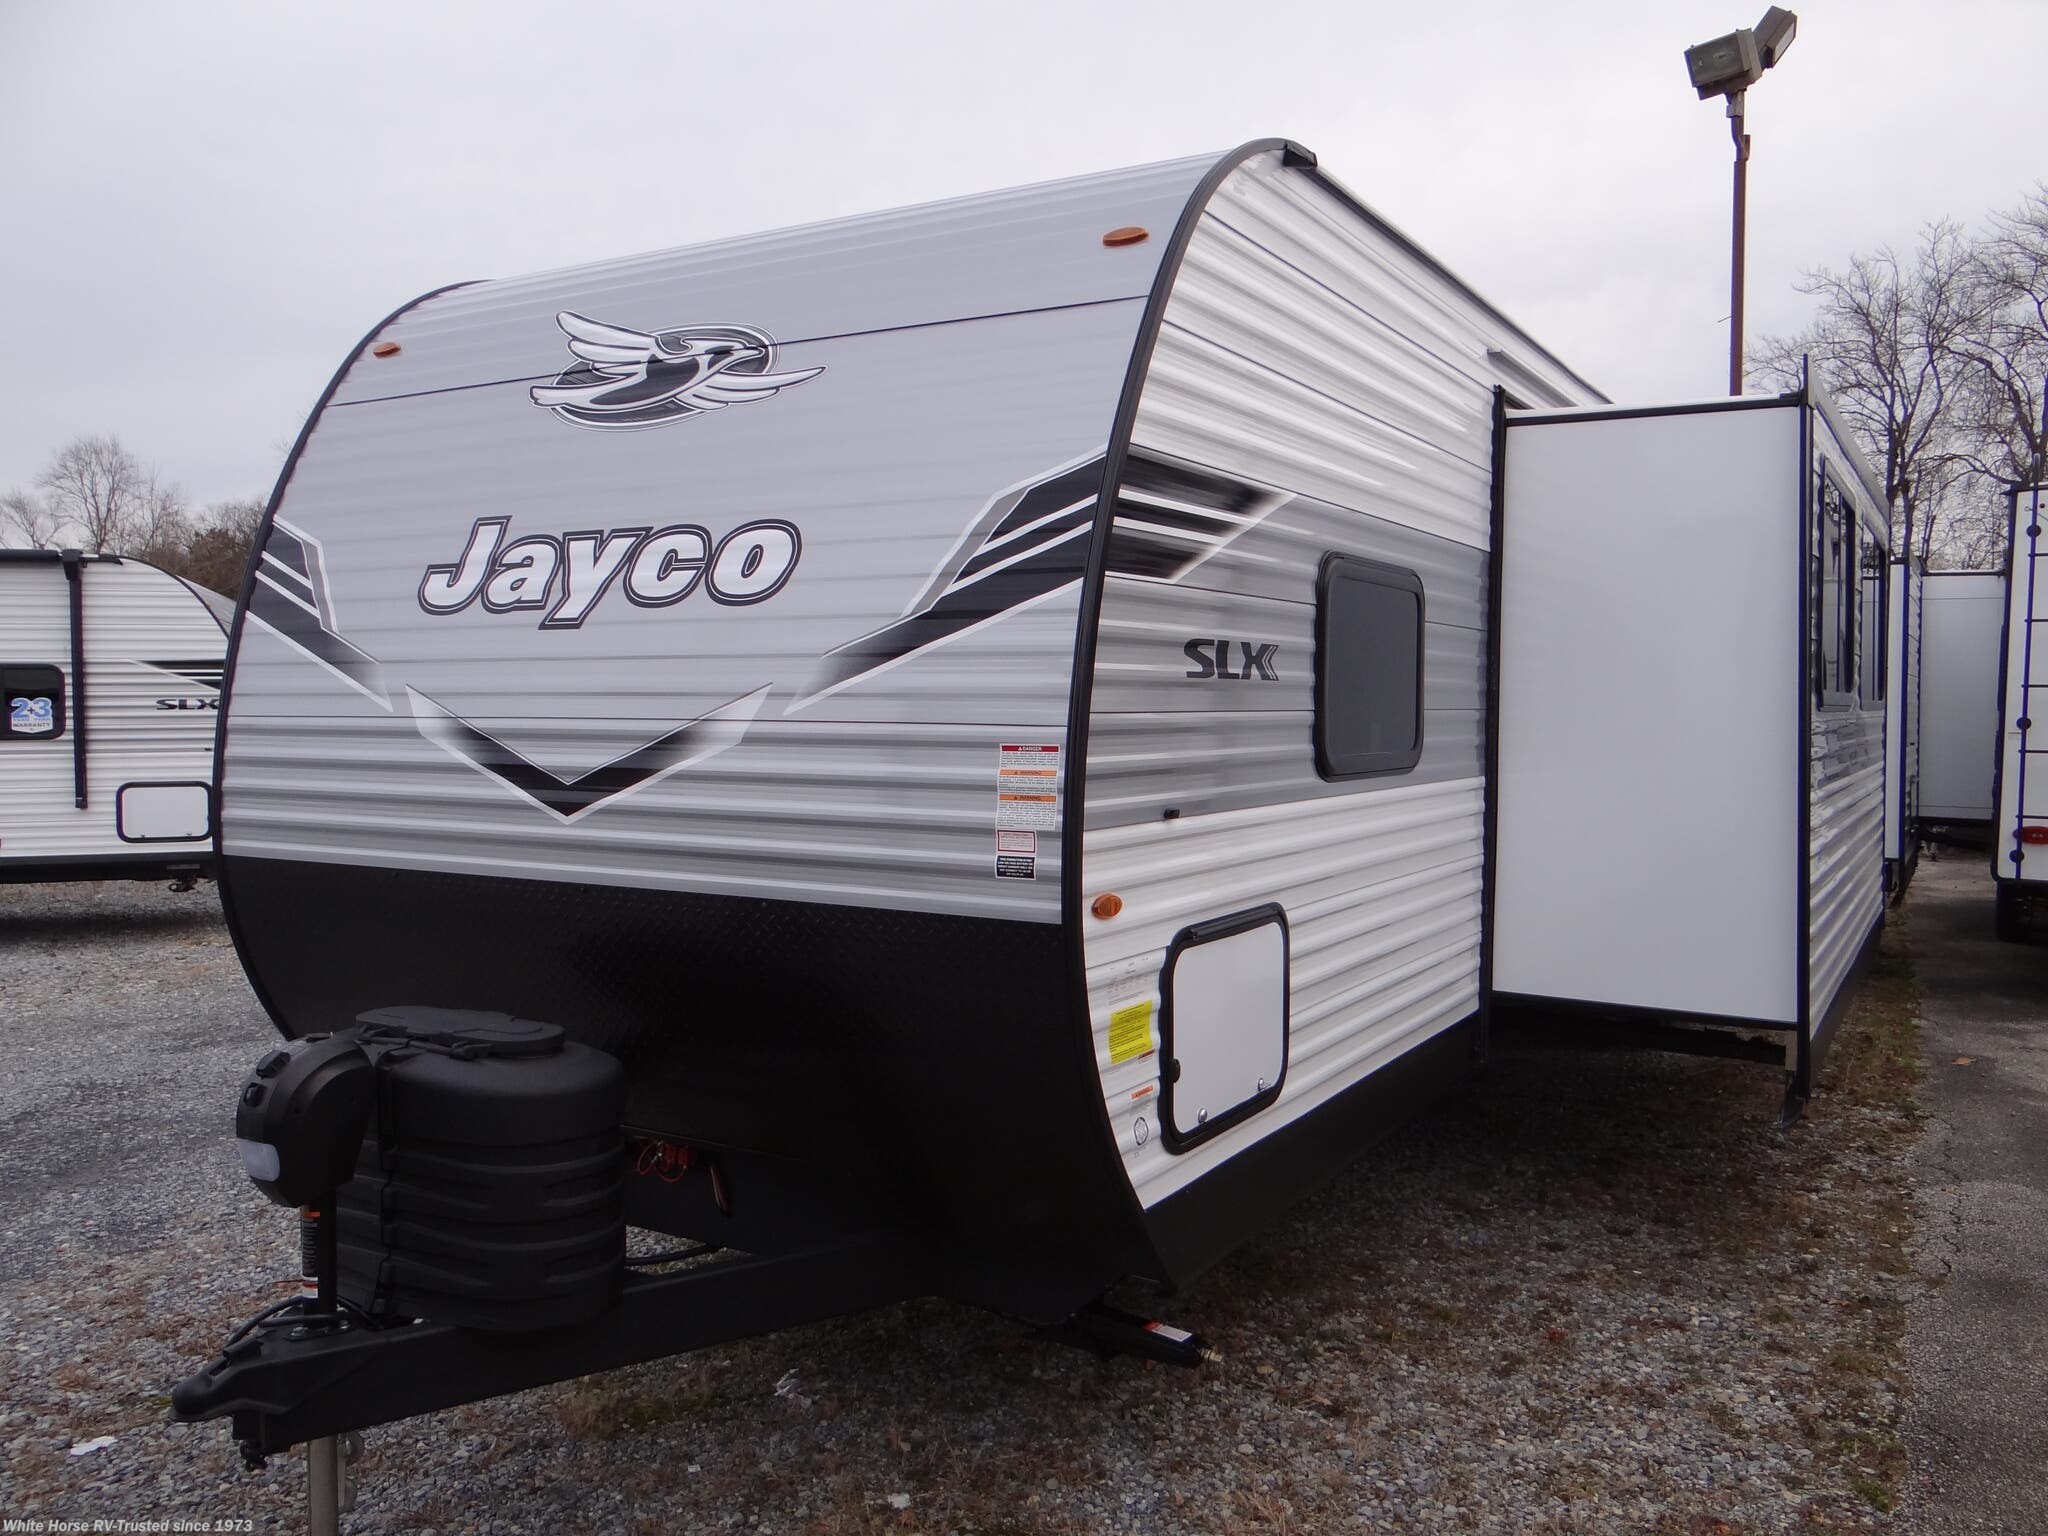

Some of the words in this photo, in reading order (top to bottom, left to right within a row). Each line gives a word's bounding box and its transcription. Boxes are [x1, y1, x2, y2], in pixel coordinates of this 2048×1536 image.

[418, 515, 802, 630] Jayco
[1184, 638, 1280, 681] SLX
[156, 698, 220, 710] SLX
